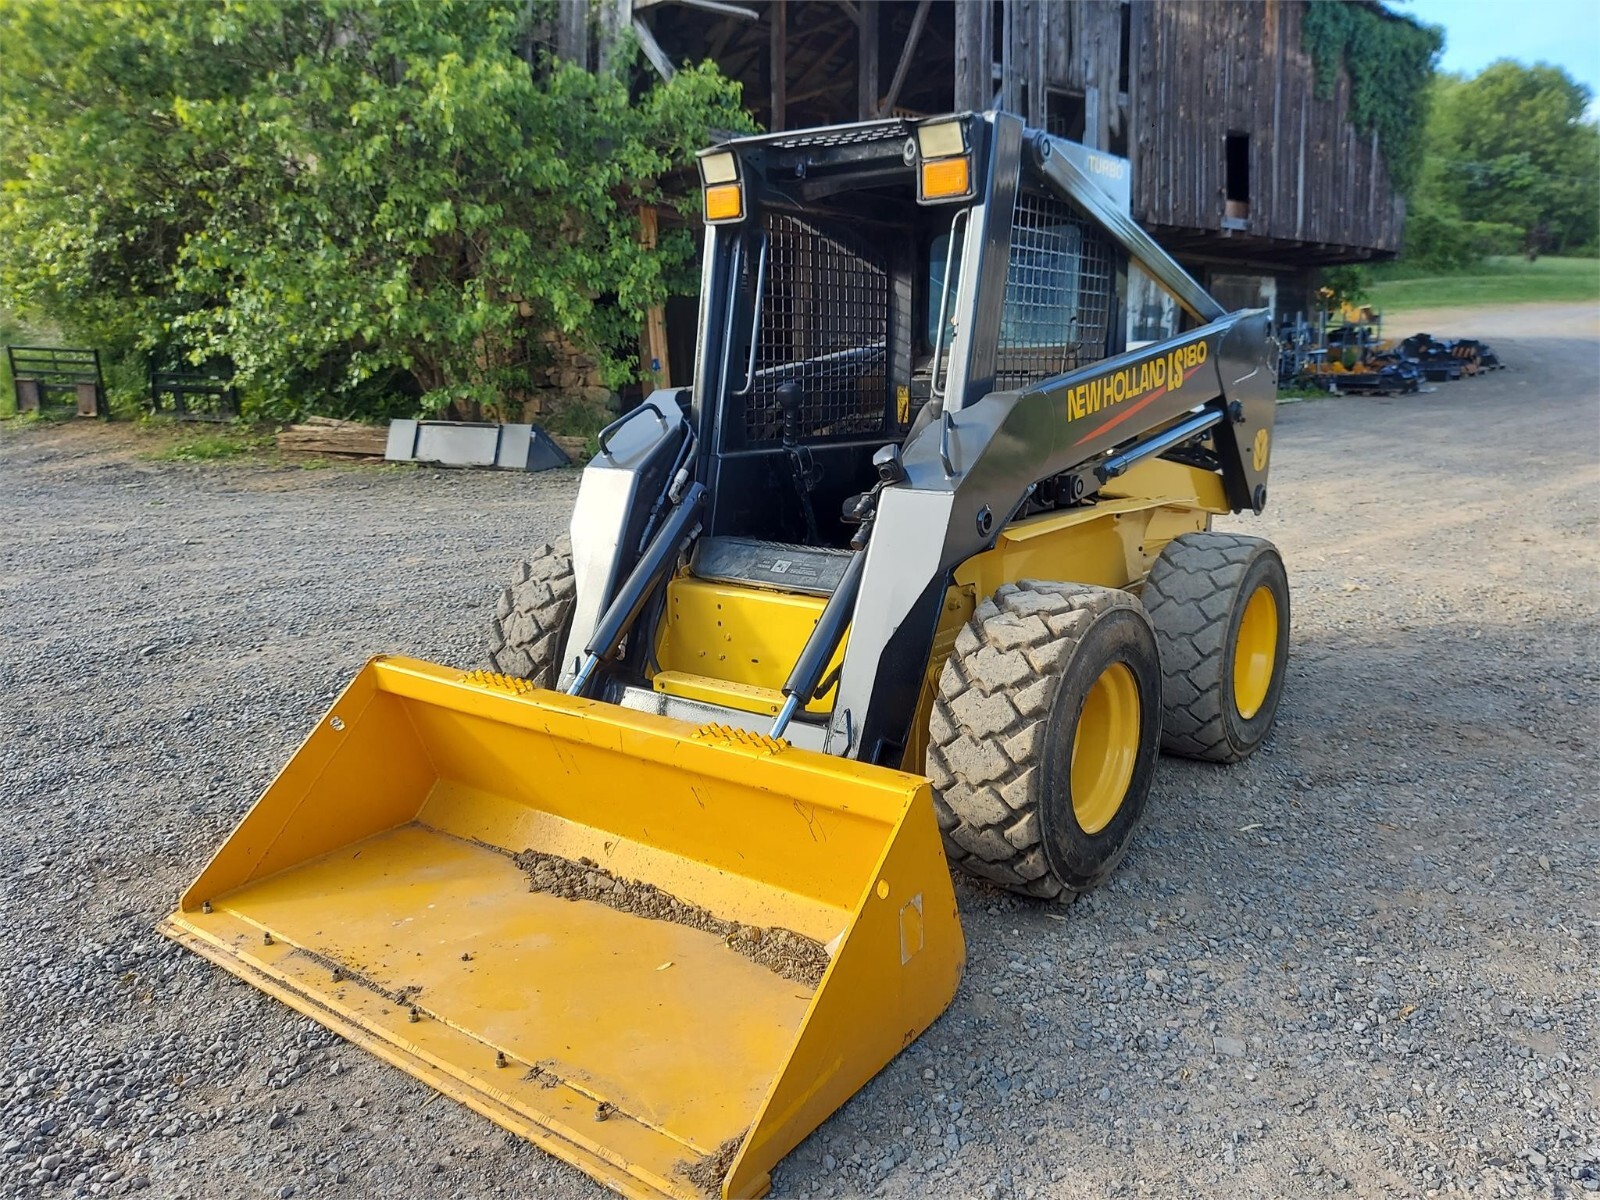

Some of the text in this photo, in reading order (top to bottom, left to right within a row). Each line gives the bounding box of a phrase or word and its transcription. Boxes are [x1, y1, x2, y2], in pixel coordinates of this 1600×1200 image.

[1088, 155, 1123, 179] TURBO
[1067, 378, 1102, 422] NEW
[1103, 358, 1166, 407] HOLLAND
